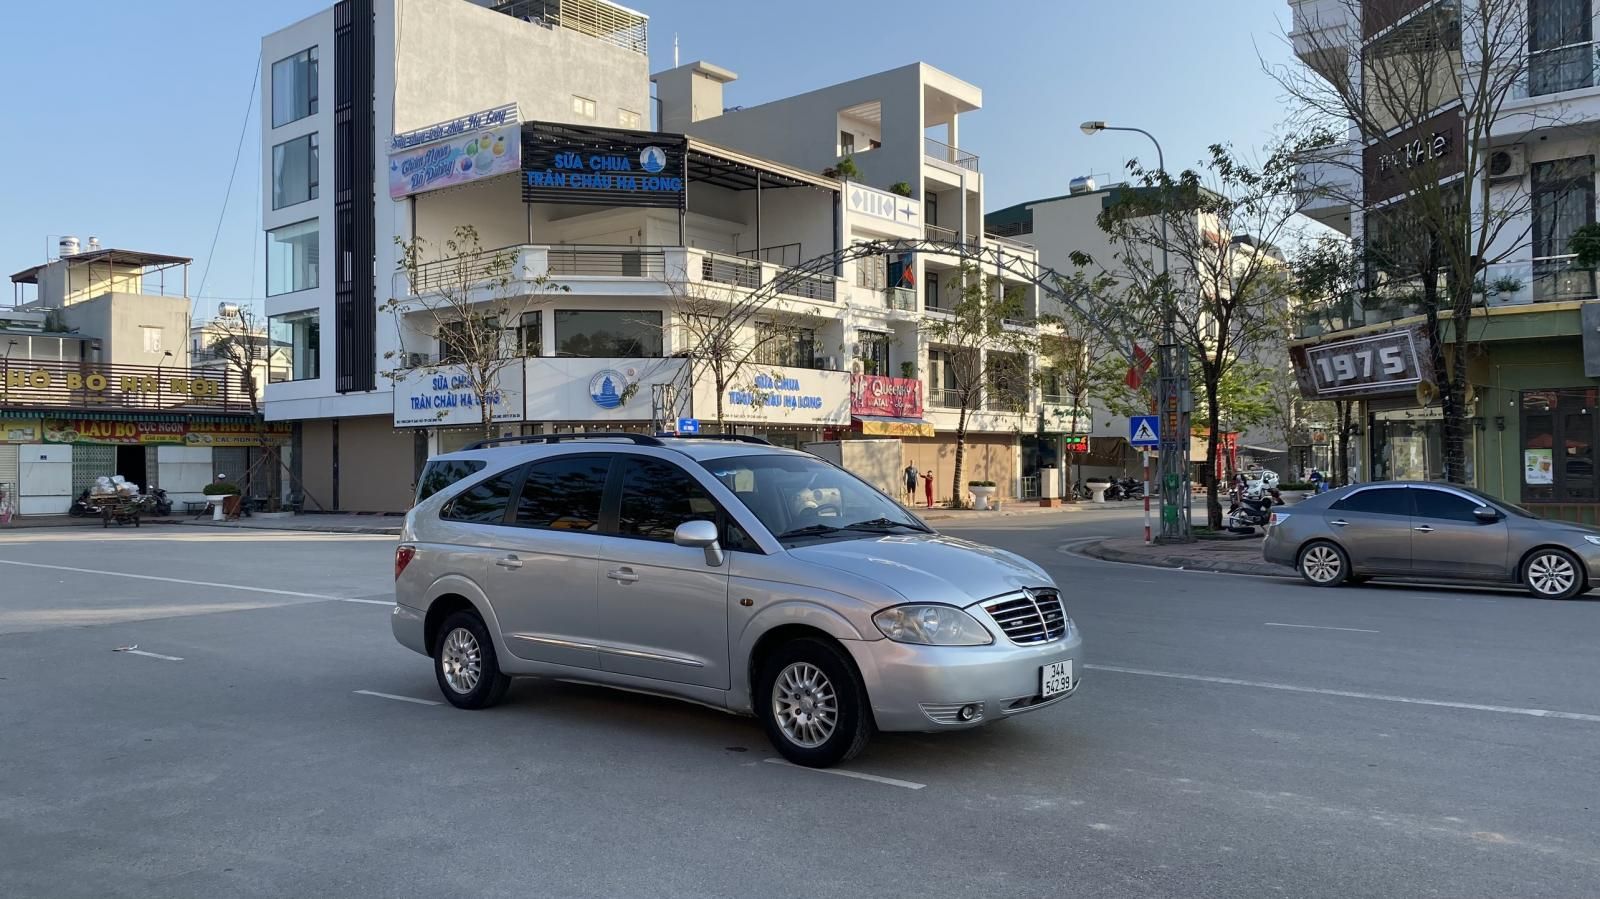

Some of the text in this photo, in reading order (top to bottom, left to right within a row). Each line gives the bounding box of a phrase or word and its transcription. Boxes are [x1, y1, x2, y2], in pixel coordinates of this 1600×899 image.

[554, 151, 632, 171] SỮA CHUA
[527, 169, 683, 193] TRÂN CHÂU HẠ LONG
[1317, 346, 1405, 382] 1975
[432, 374, 448, 390] SỮA
[755, 373, 800, 391] SỮA CHUA
[411, 393, 432, 410] TRÂN
[433, 391, 458, 408] CHÂU
[460, 393, 473, 409] HẠ
[798, 396, 822, 410] LONG
[1051, 663, 1065, 678] 34A
[1046, 676, 1070, 694] 542.99
